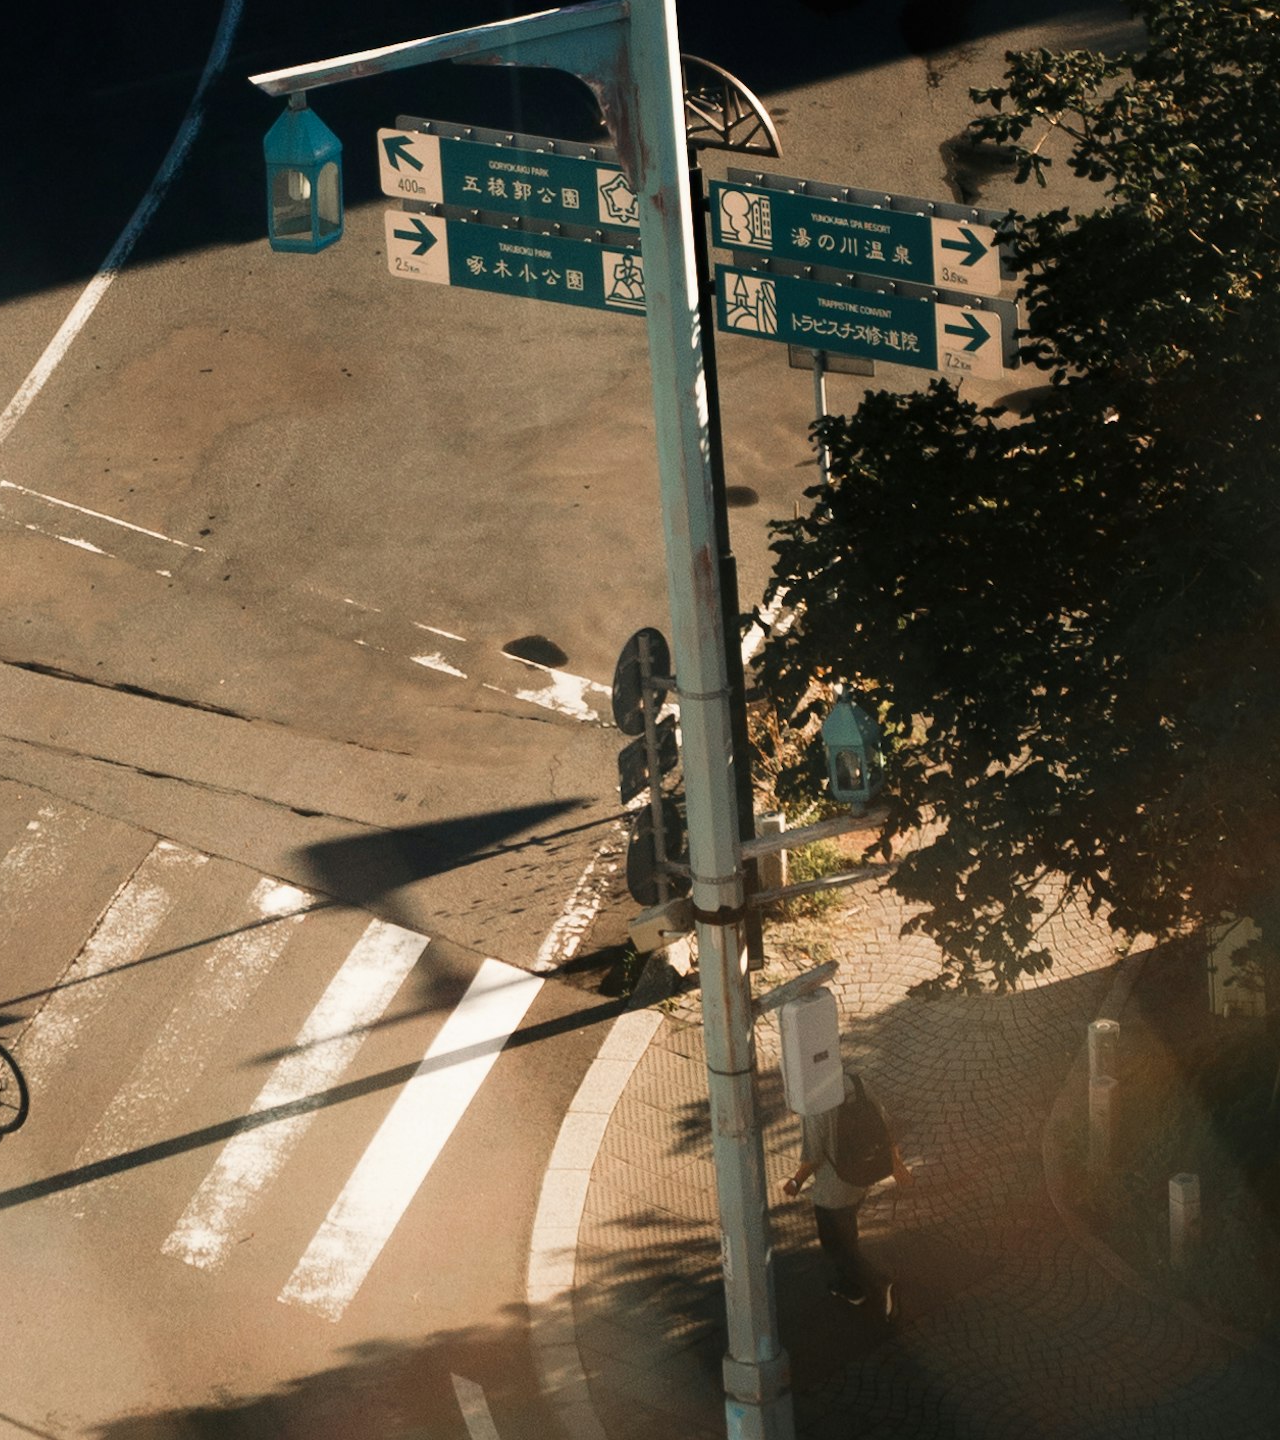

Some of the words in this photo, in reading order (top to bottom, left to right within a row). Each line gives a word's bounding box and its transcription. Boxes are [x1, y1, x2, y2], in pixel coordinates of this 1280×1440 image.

[488, 159, 531, 176] GORYOKAKU
[531, 166, 550, 178] PARK
[398, 178, 426, 195] 400m
[462, 175, 580, 210] 五稜郭公園
[810, 212, 849, 228] YUNOKAWA
[849, 219, 863, 229] SPA
[863, 222, 891, 234] RESORT
[498, 242, 534, 257] TAKUBOKU
[534, 248, 552, 260] PARK
[790, 227, 913, 266] 湯の川温泉
[466, 255, 584, 291] 啄木小公園
[817, 296, 859, 313] TRAPPISTINE
[859, 305, 892, 319] CONVENT
[791, 313, 920, 353] トラピスチヌ修道院
